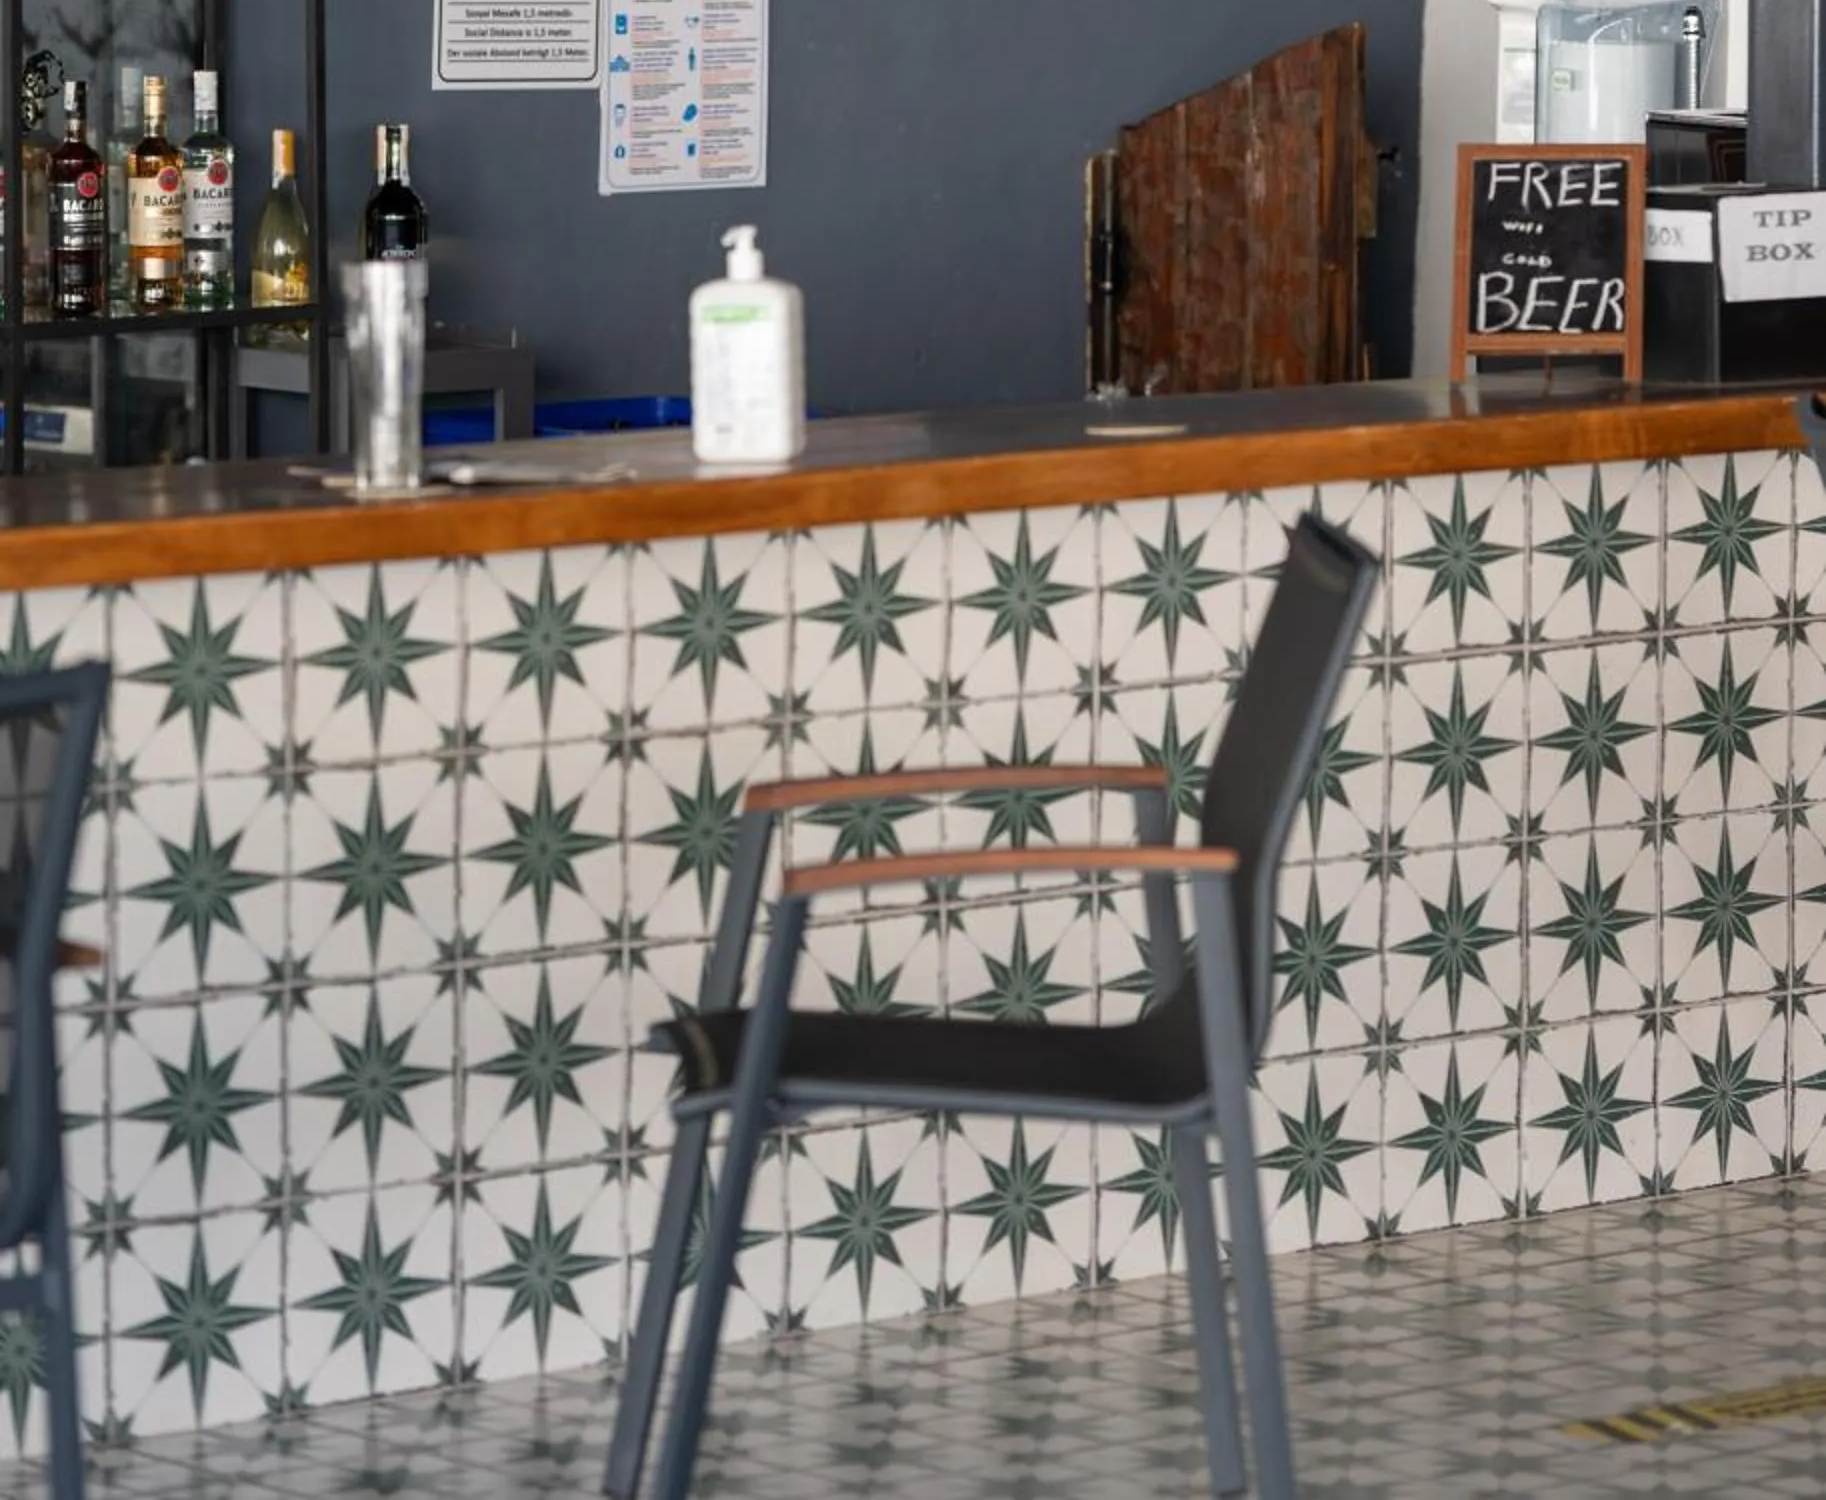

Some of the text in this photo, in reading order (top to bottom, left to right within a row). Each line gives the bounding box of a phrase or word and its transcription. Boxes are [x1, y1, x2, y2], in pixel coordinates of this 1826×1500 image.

[465, 28, 489, 37] Social
[1488, 162, 1623, 211] FREE
[1753, 209, 1813, 228] TIP
[1502, 252, 1553, 269] COLD
[1745, 242, 1816, 263] BOX
[1477, 271, 1625, 335] BEER
